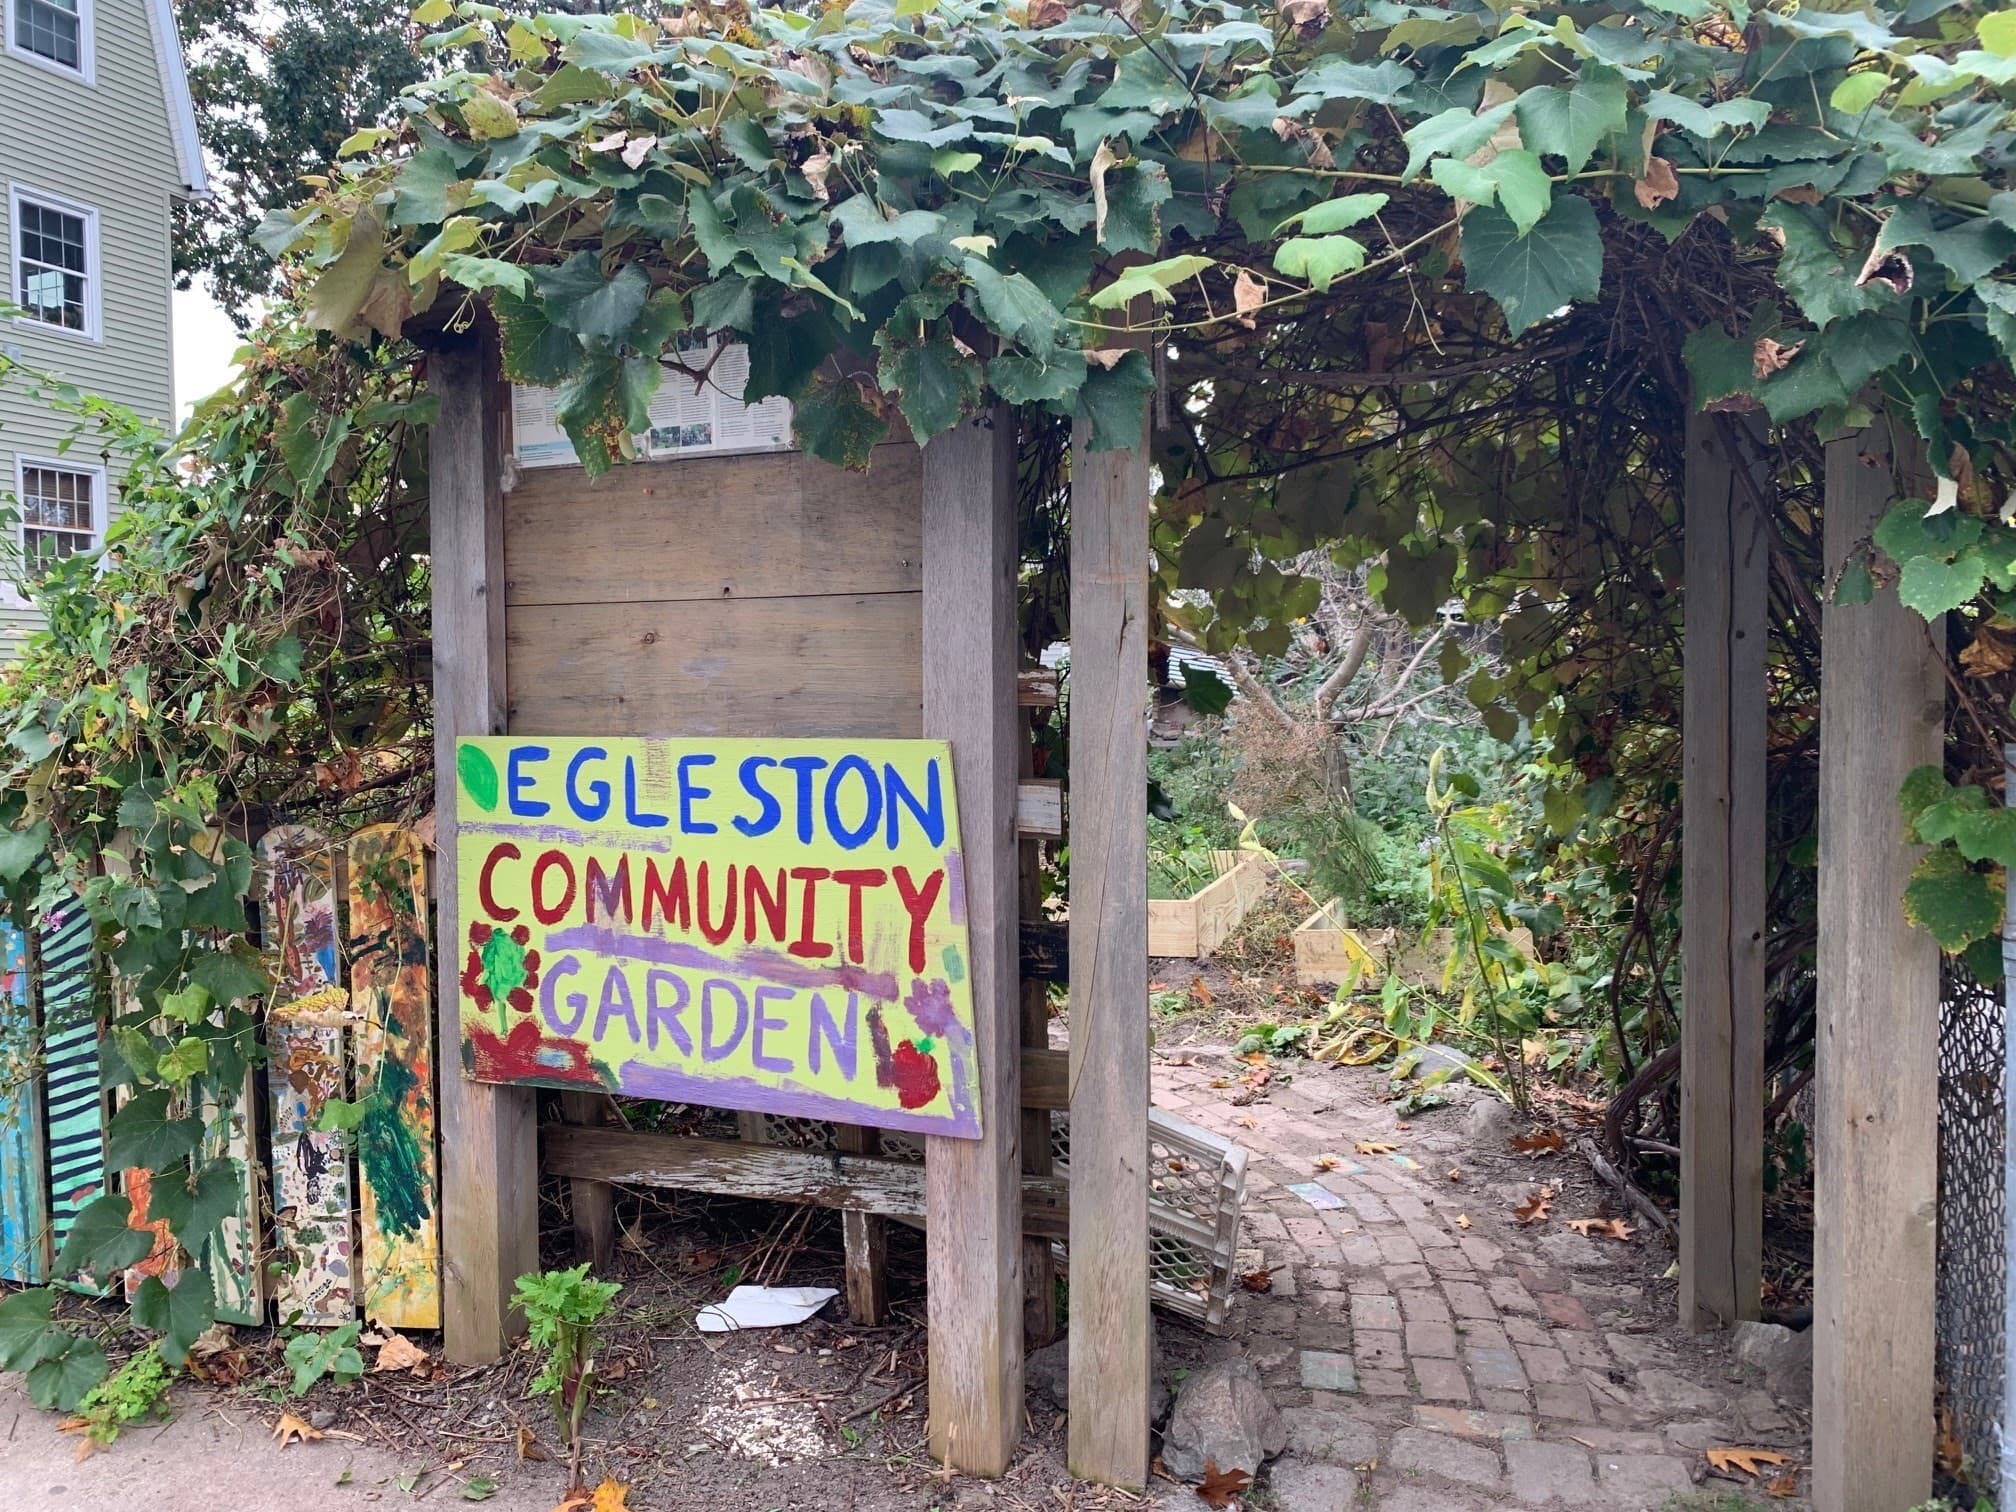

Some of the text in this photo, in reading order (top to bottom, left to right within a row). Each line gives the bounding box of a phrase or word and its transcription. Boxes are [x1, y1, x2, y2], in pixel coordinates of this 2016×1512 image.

[507, 746, 945, 849] EGLESTON
[479, 843, 945, 974] COMMUNITY
[540, 955, 858, 1080] GARDEN
